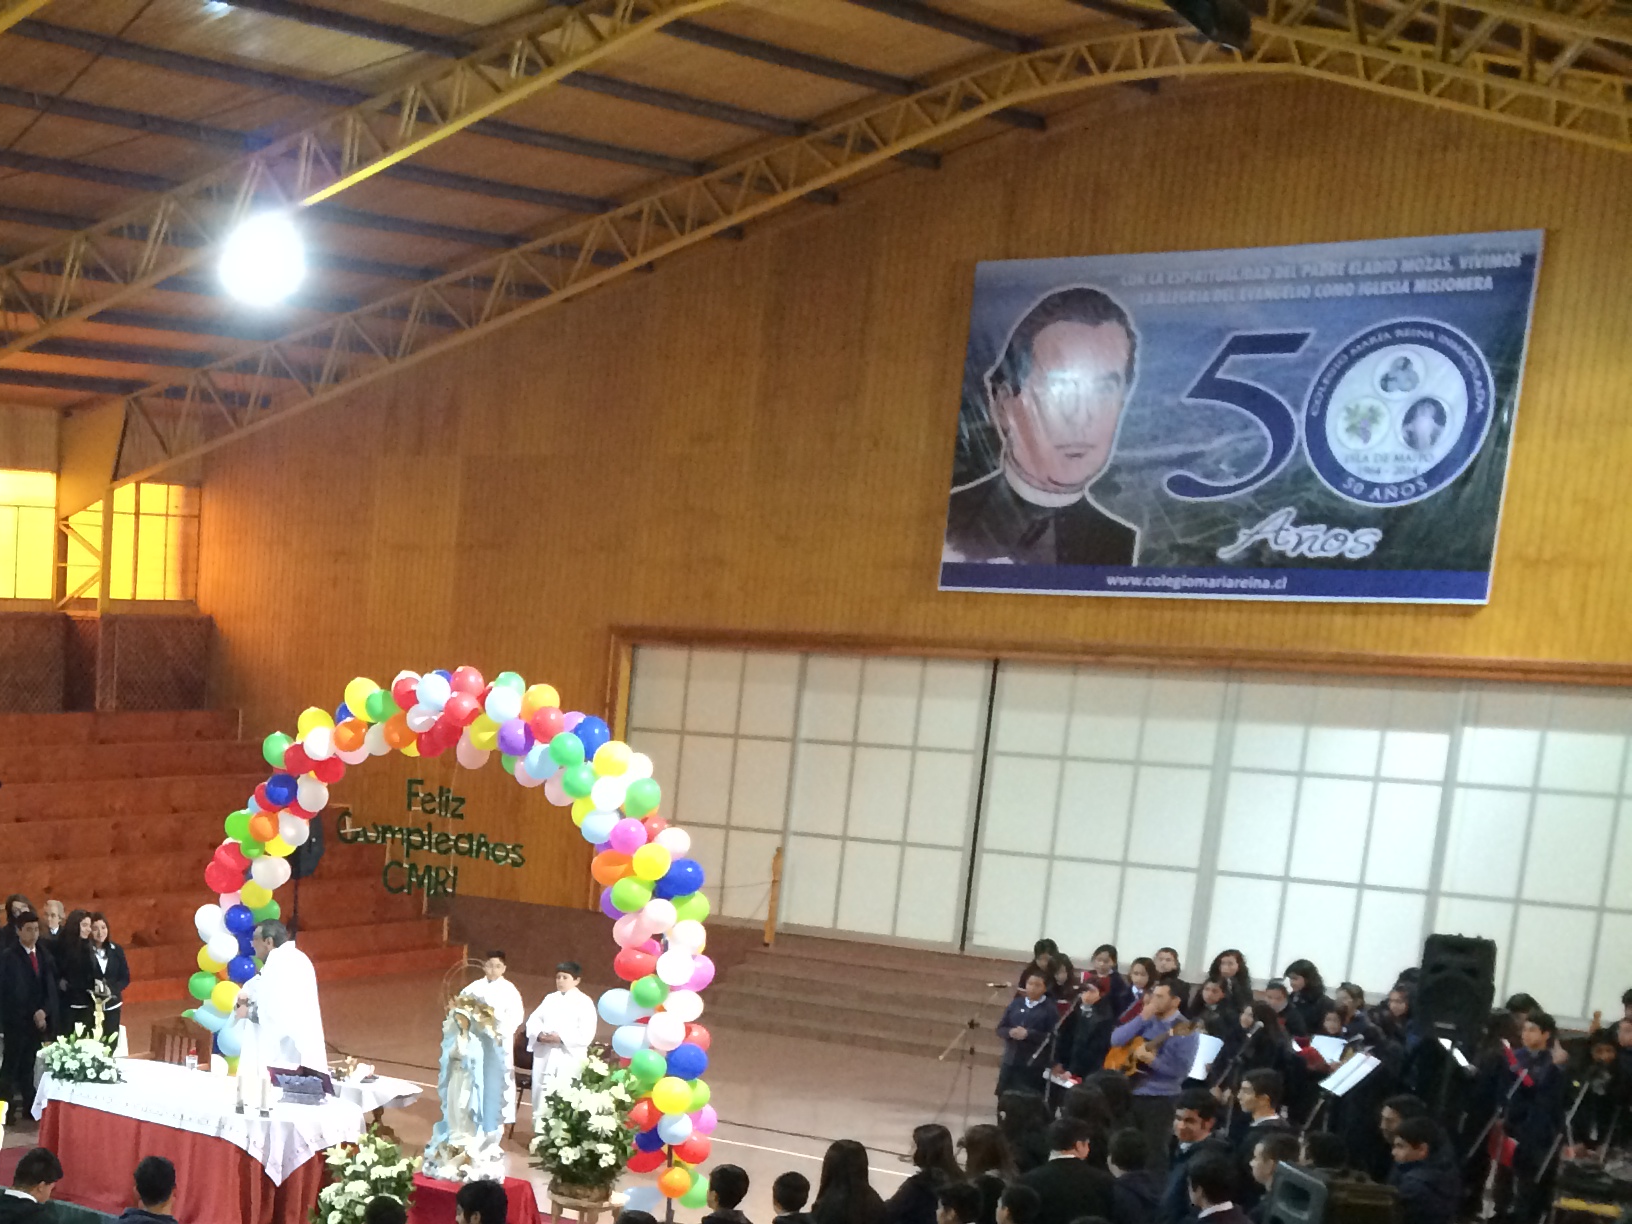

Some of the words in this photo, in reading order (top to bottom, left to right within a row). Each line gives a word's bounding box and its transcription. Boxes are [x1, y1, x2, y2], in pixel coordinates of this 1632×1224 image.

[1458, 252, 1522, 269] VIVIMOS
[1314, 282, 1355, 298] COMO
[1412, 275, 1494, 293] MISIONERA
[1342, 476, 1365, 495] 50
[1369, 475, 1429, 501] AÑOS
[1217, 506, 1383, 560] Años
[1106, 573, 1288, 590] www.colegiomariareina.cl
[406, 778, 466, 820] Feliz
[381, 860, 459, 898] CMRI
